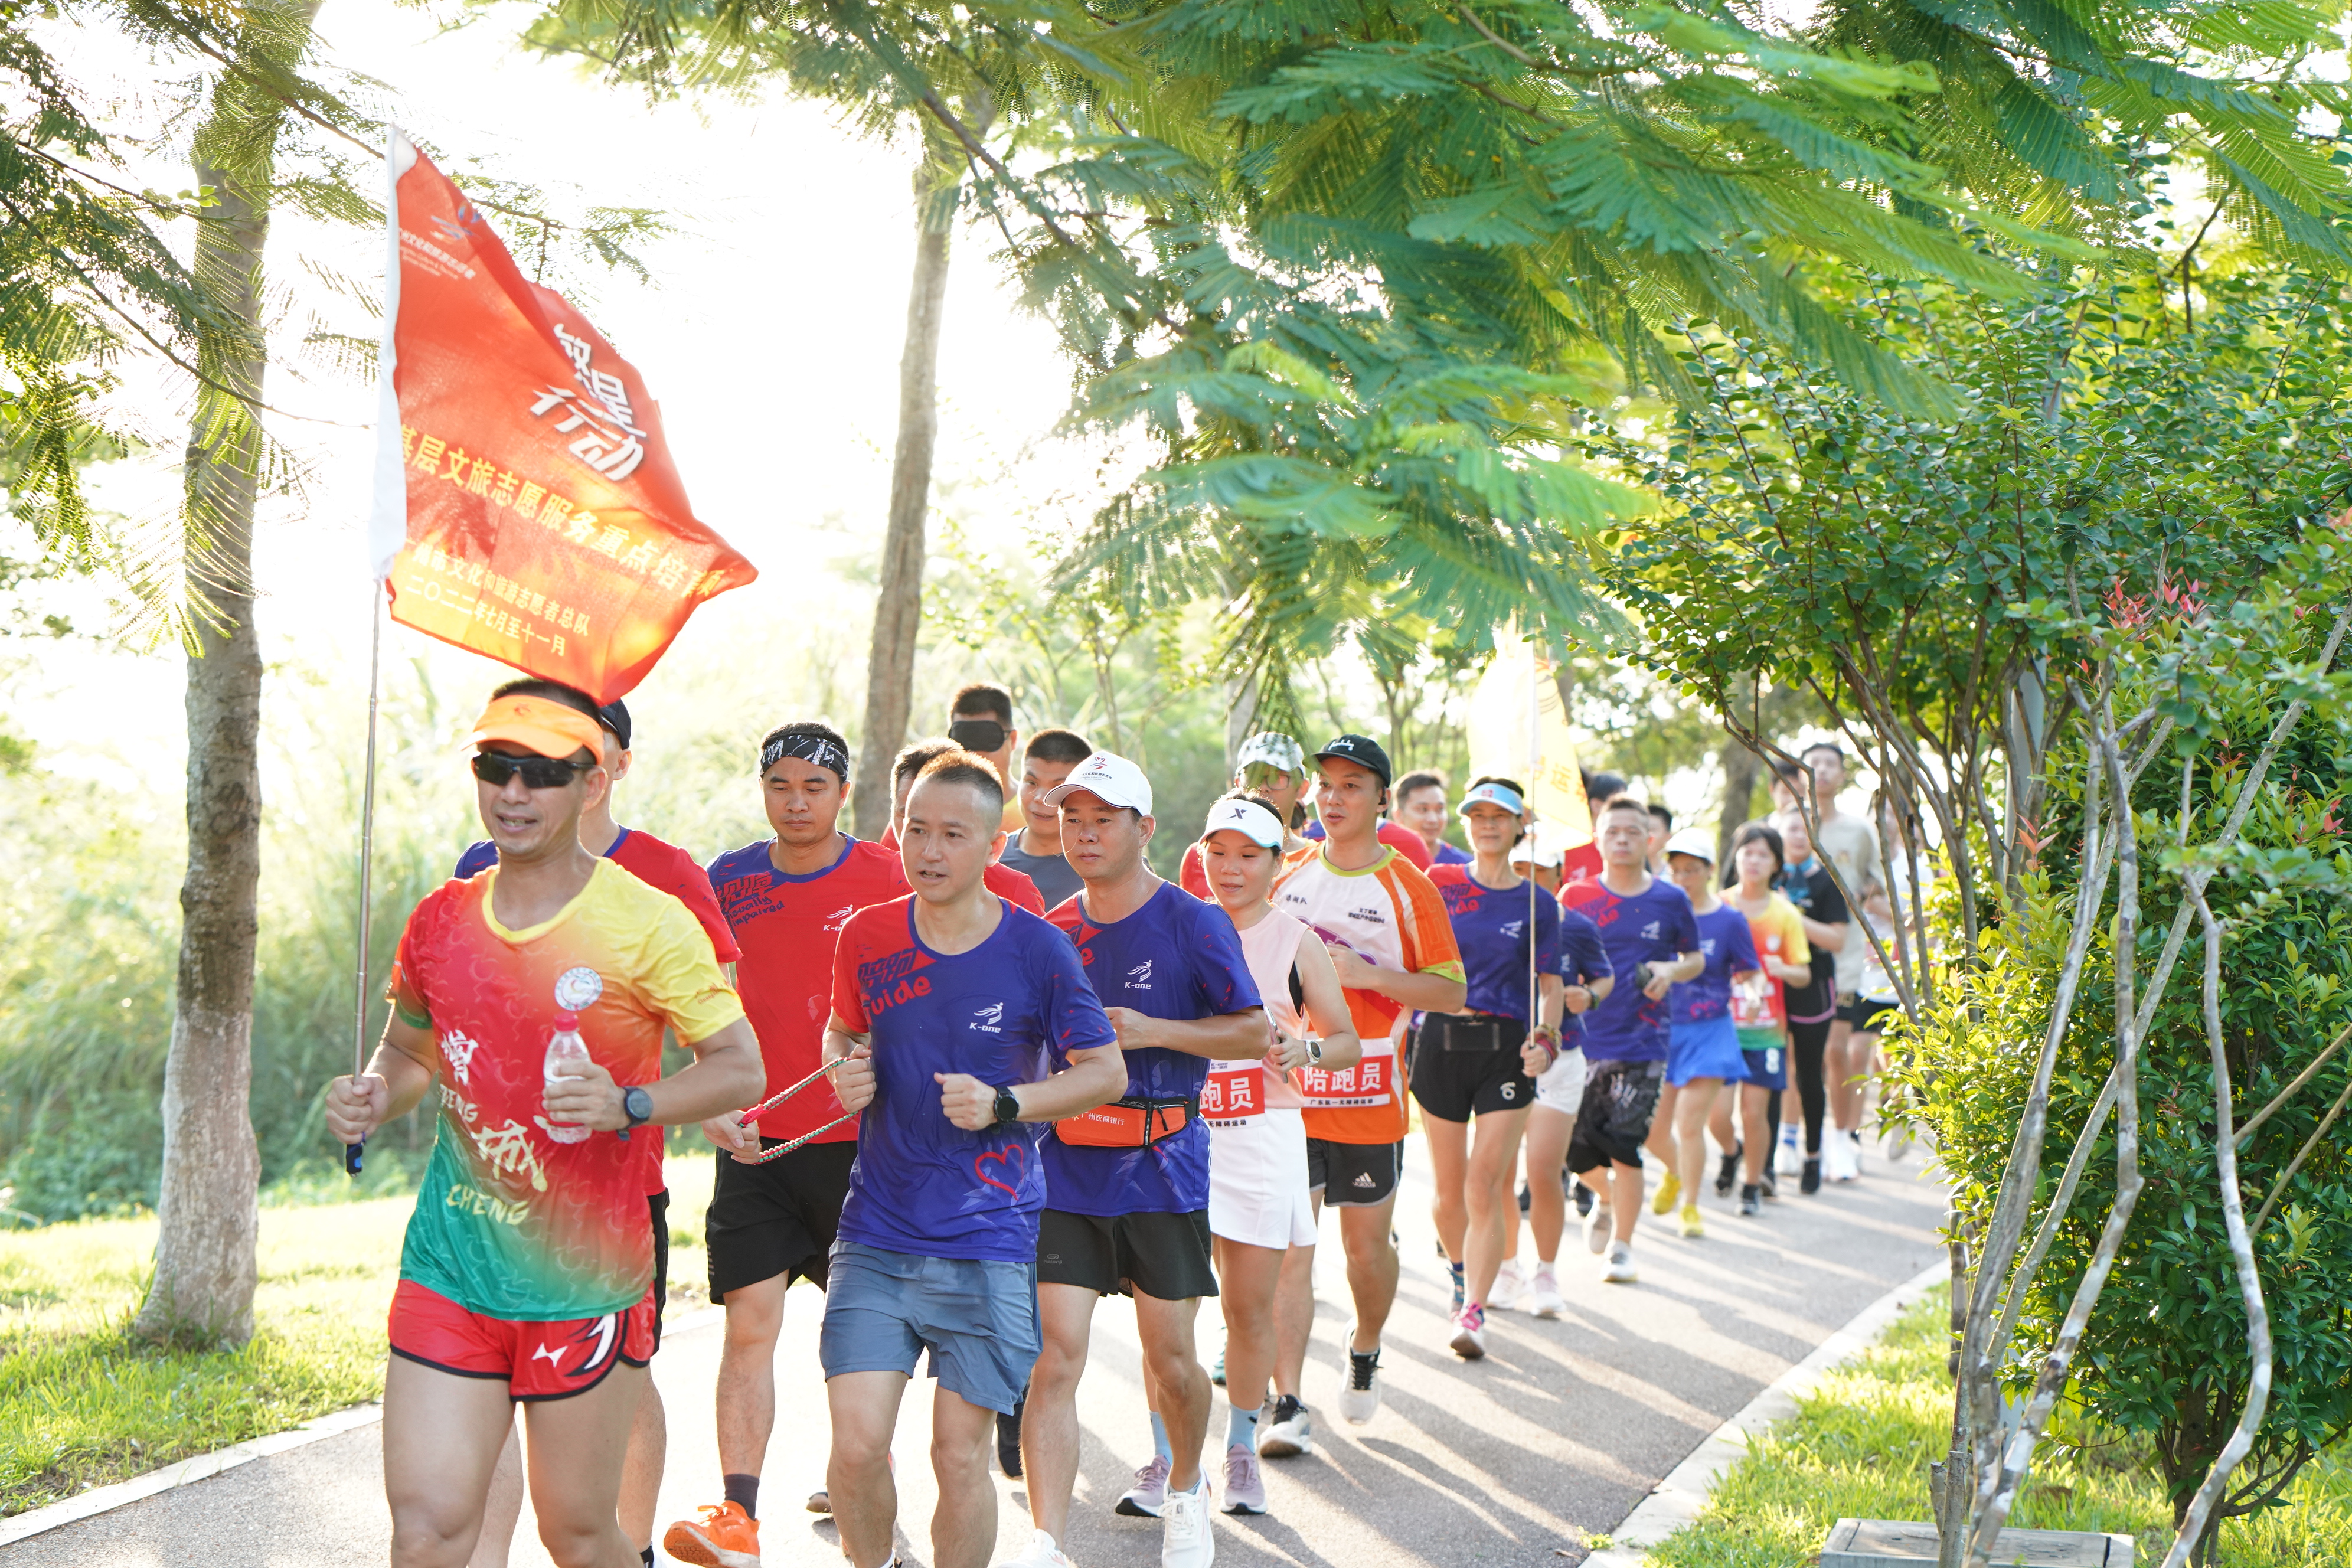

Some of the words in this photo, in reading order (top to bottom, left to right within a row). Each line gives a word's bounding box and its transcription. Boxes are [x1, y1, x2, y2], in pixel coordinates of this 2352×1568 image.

[529, 384, 644, 481] 行动
[406, 538, 591, 637] 州市文化和旅游志愿者总队
[733, 900, 785, 926] impaired
[1125, 981, 1152, 989] K-one
[969, 1022, 1002, 1034] K-one
[1304, 1063, 1382, 1092] 陪跑员
[1081, 1111, 1125, 1126] 广州农商银行
[446, 1183, 530, 1226] CHENG
